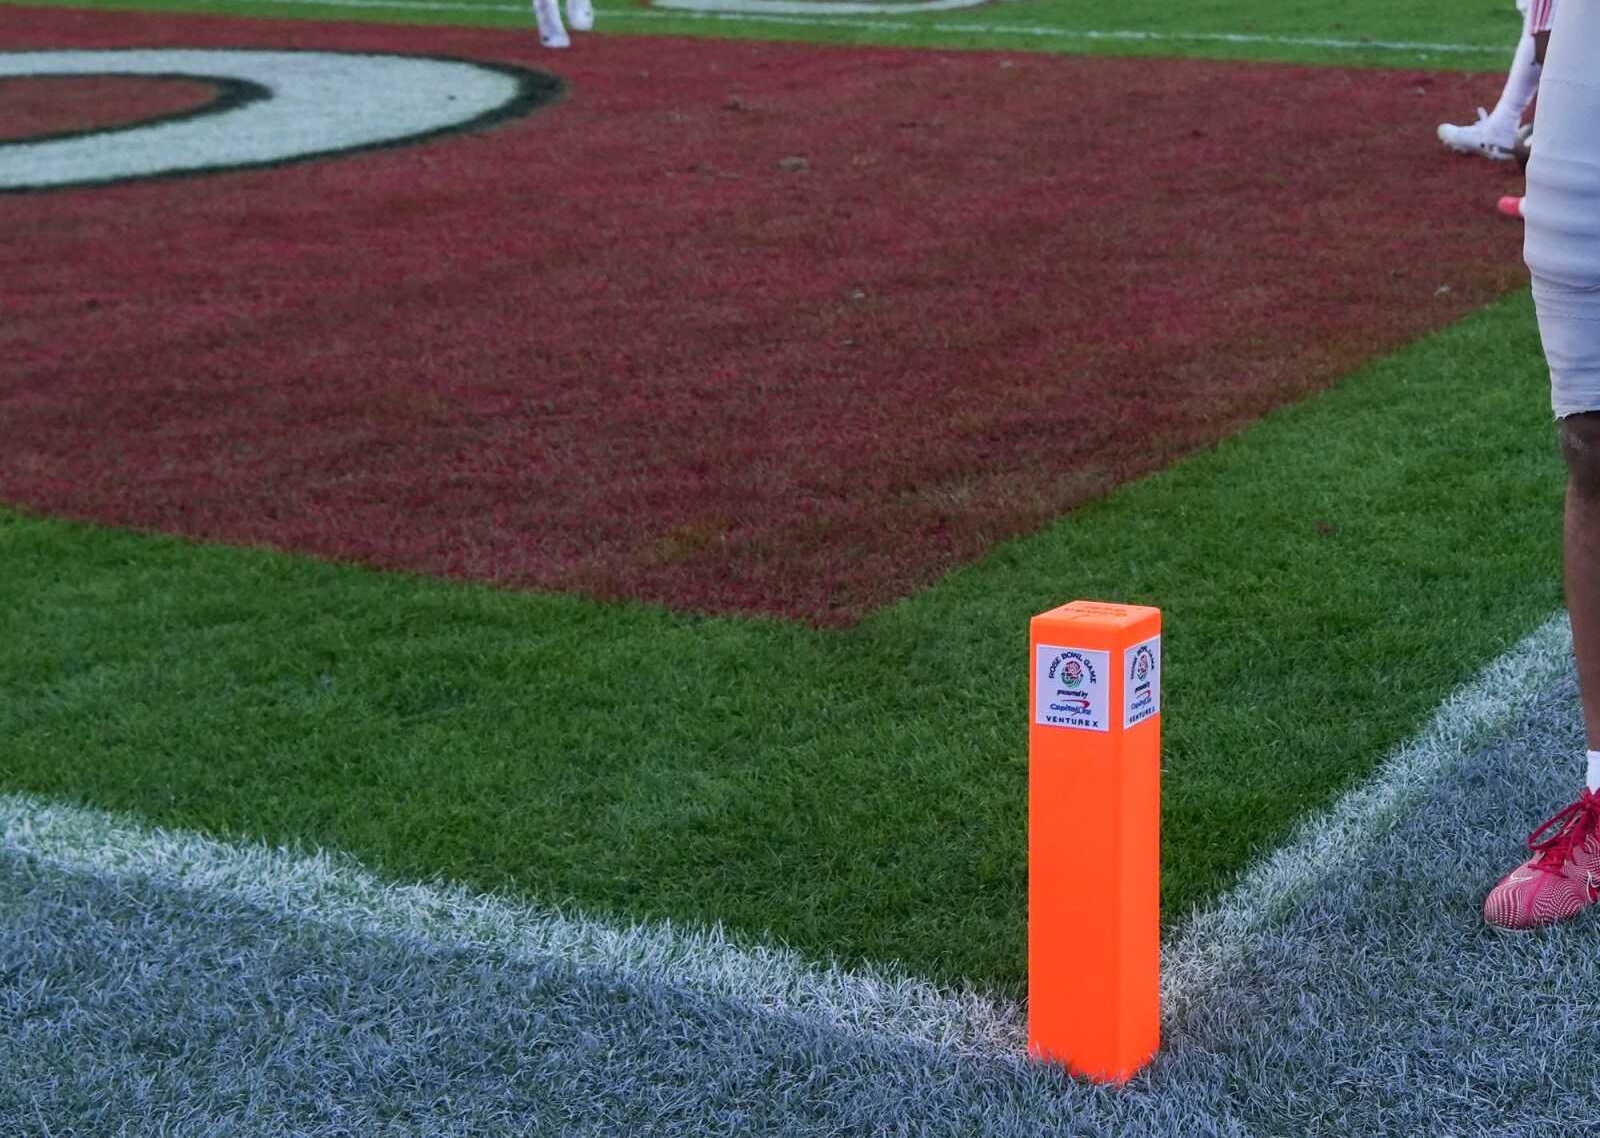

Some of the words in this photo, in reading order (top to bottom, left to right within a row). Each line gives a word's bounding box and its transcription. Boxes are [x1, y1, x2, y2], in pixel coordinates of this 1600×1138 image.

[1049, 656, 1062, 679] ROSE
[1061, 651, 1083, 662] BOWL
[1083, 659, 1097, 684] GAME
[1046, 715, 1090, 725] VENTURE
